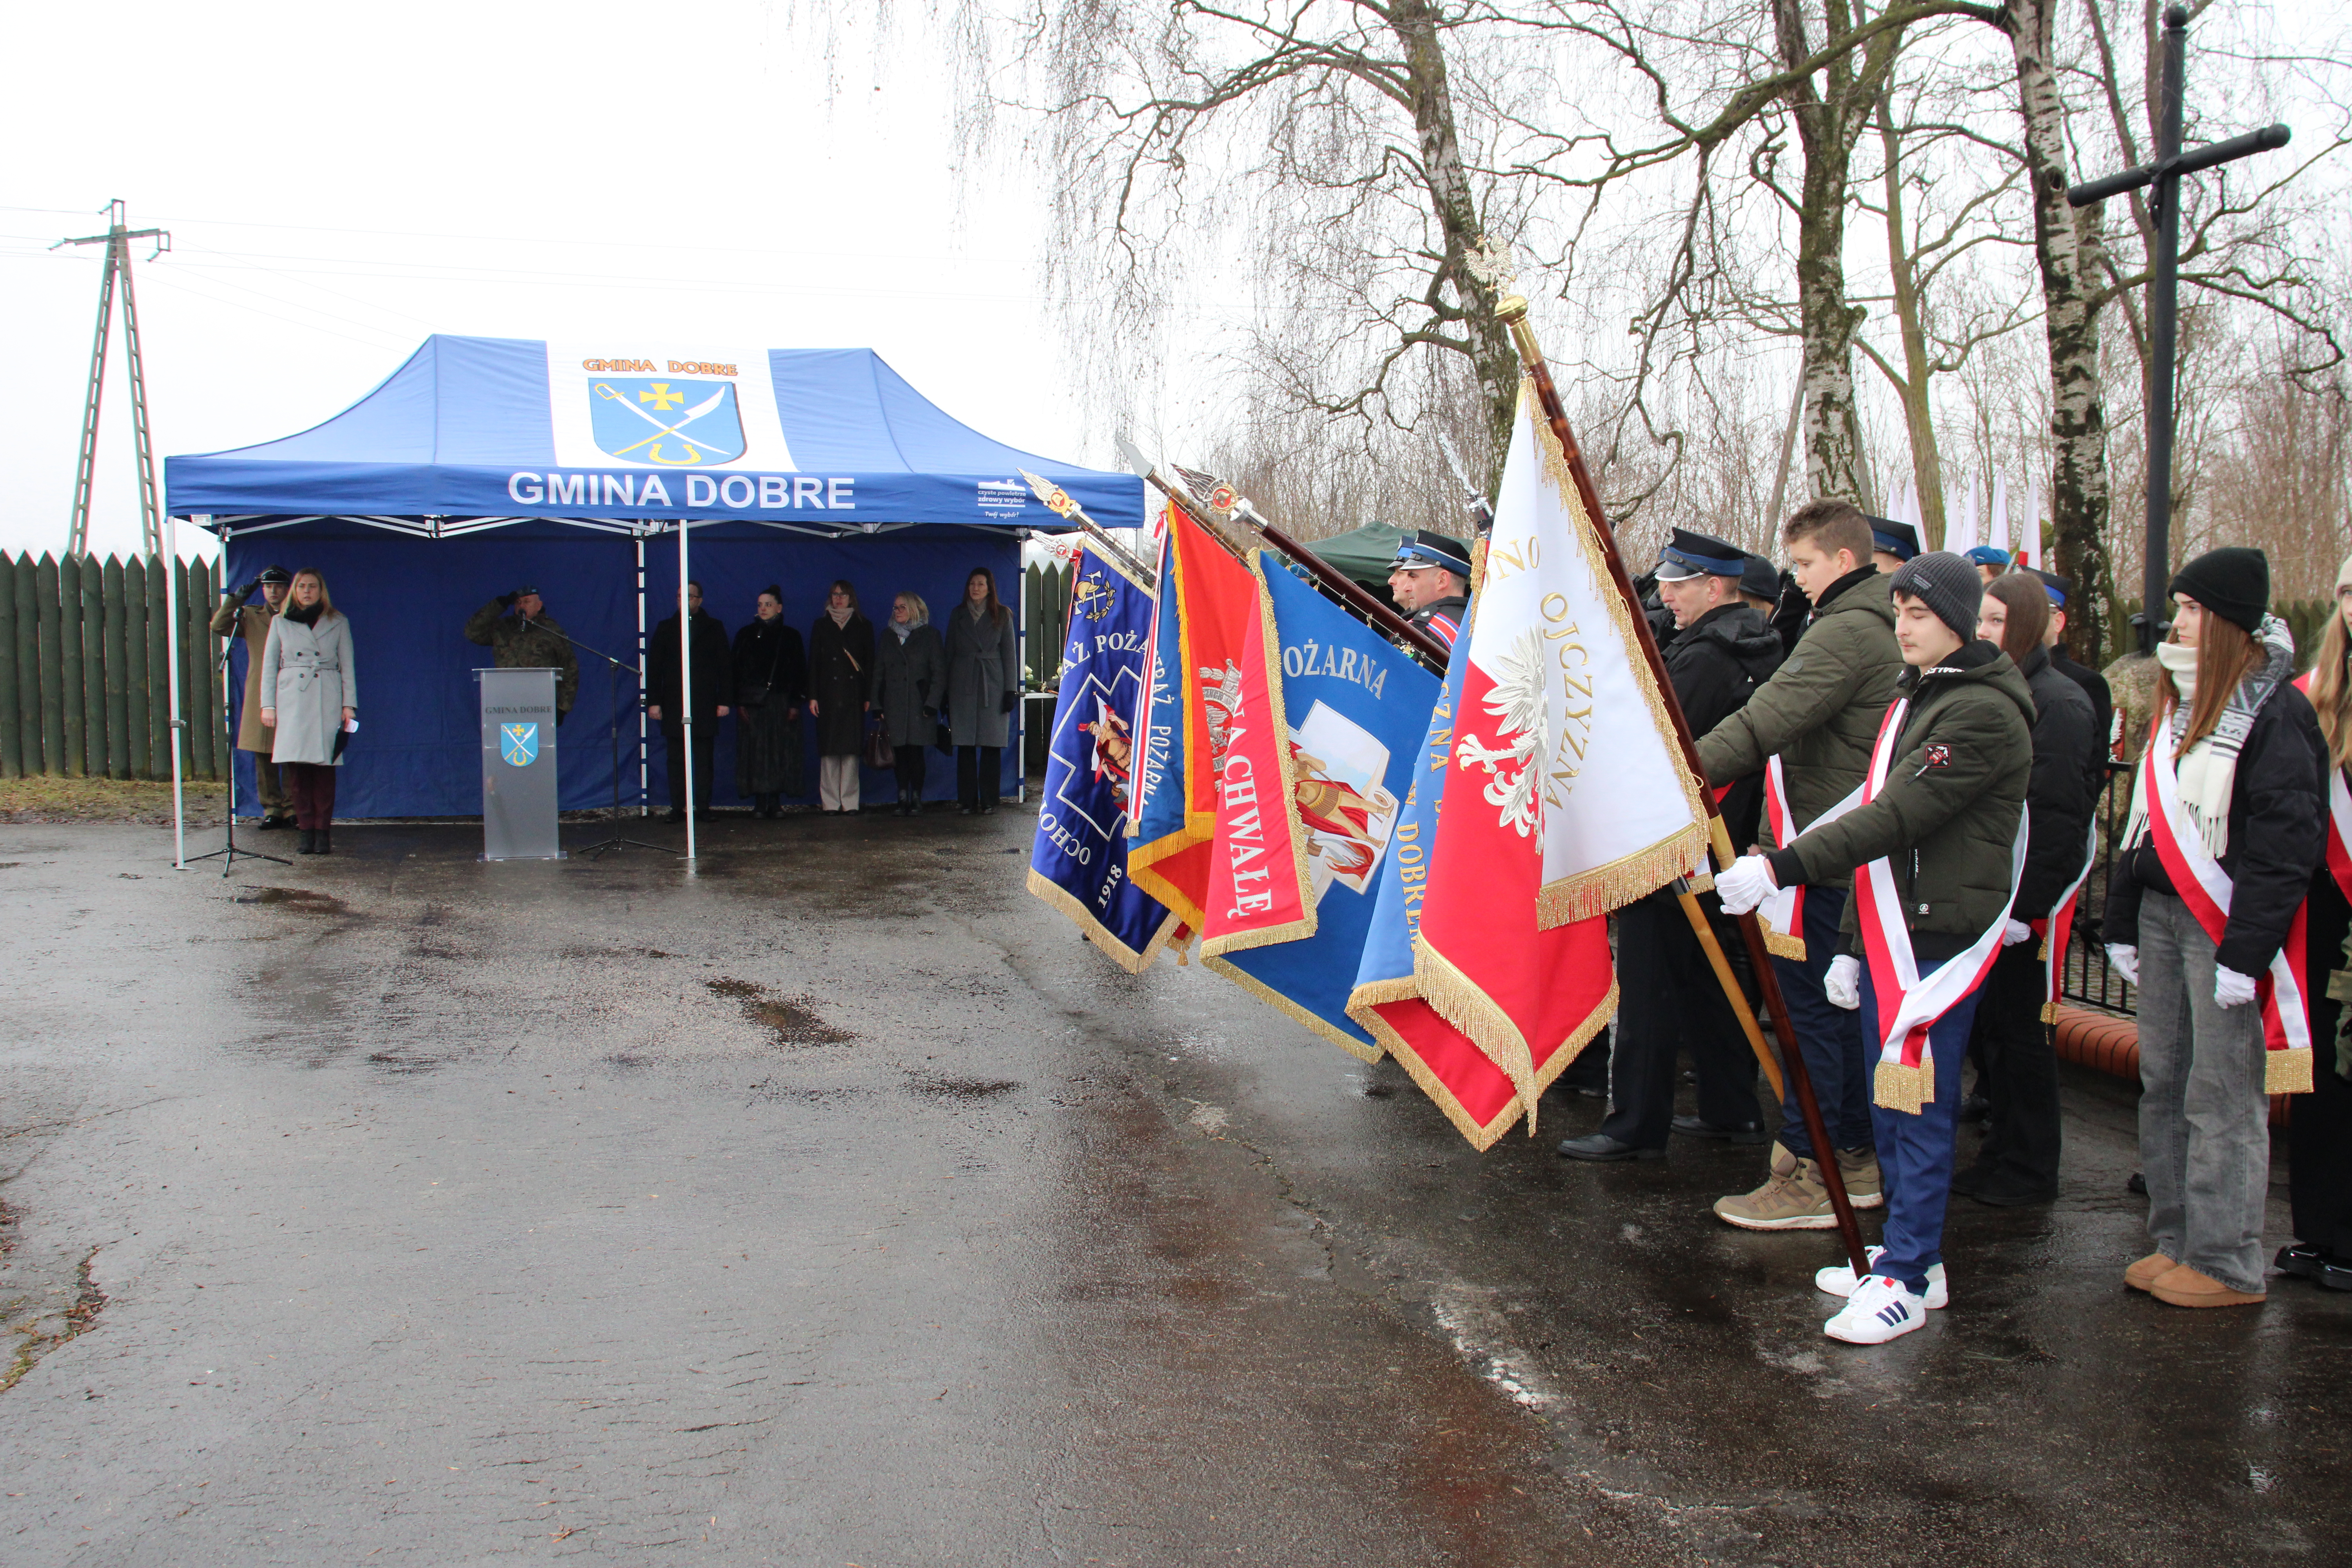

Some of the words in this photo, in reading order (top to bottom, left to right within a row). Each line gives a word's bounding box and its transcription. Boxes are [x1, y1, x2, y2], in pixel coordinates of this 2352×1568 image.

[583, 359, 657, 372] GMINA
[668, 360, 738, 376] DOBRE
[508, 471, 673, 507] GMINA
[686, 474, 856, 510] DOBRE
[1060, 641, 1091, 682] AŻ
[1094, 630, 1149, 655] POŻA
[1152, 651, 1175, 706] TRAŻ
[1283, 638, 1388, 701] OŻARNA
[485, 706, 518, 715] GMINA
[519, 705, 552, 714] DOBRE
[1540, 592, 1593, 810] OJCZYZNA
[1224, 755, 1273, 920] CHWAŁĘ
[1098, 864, 1122, 908] 1918
